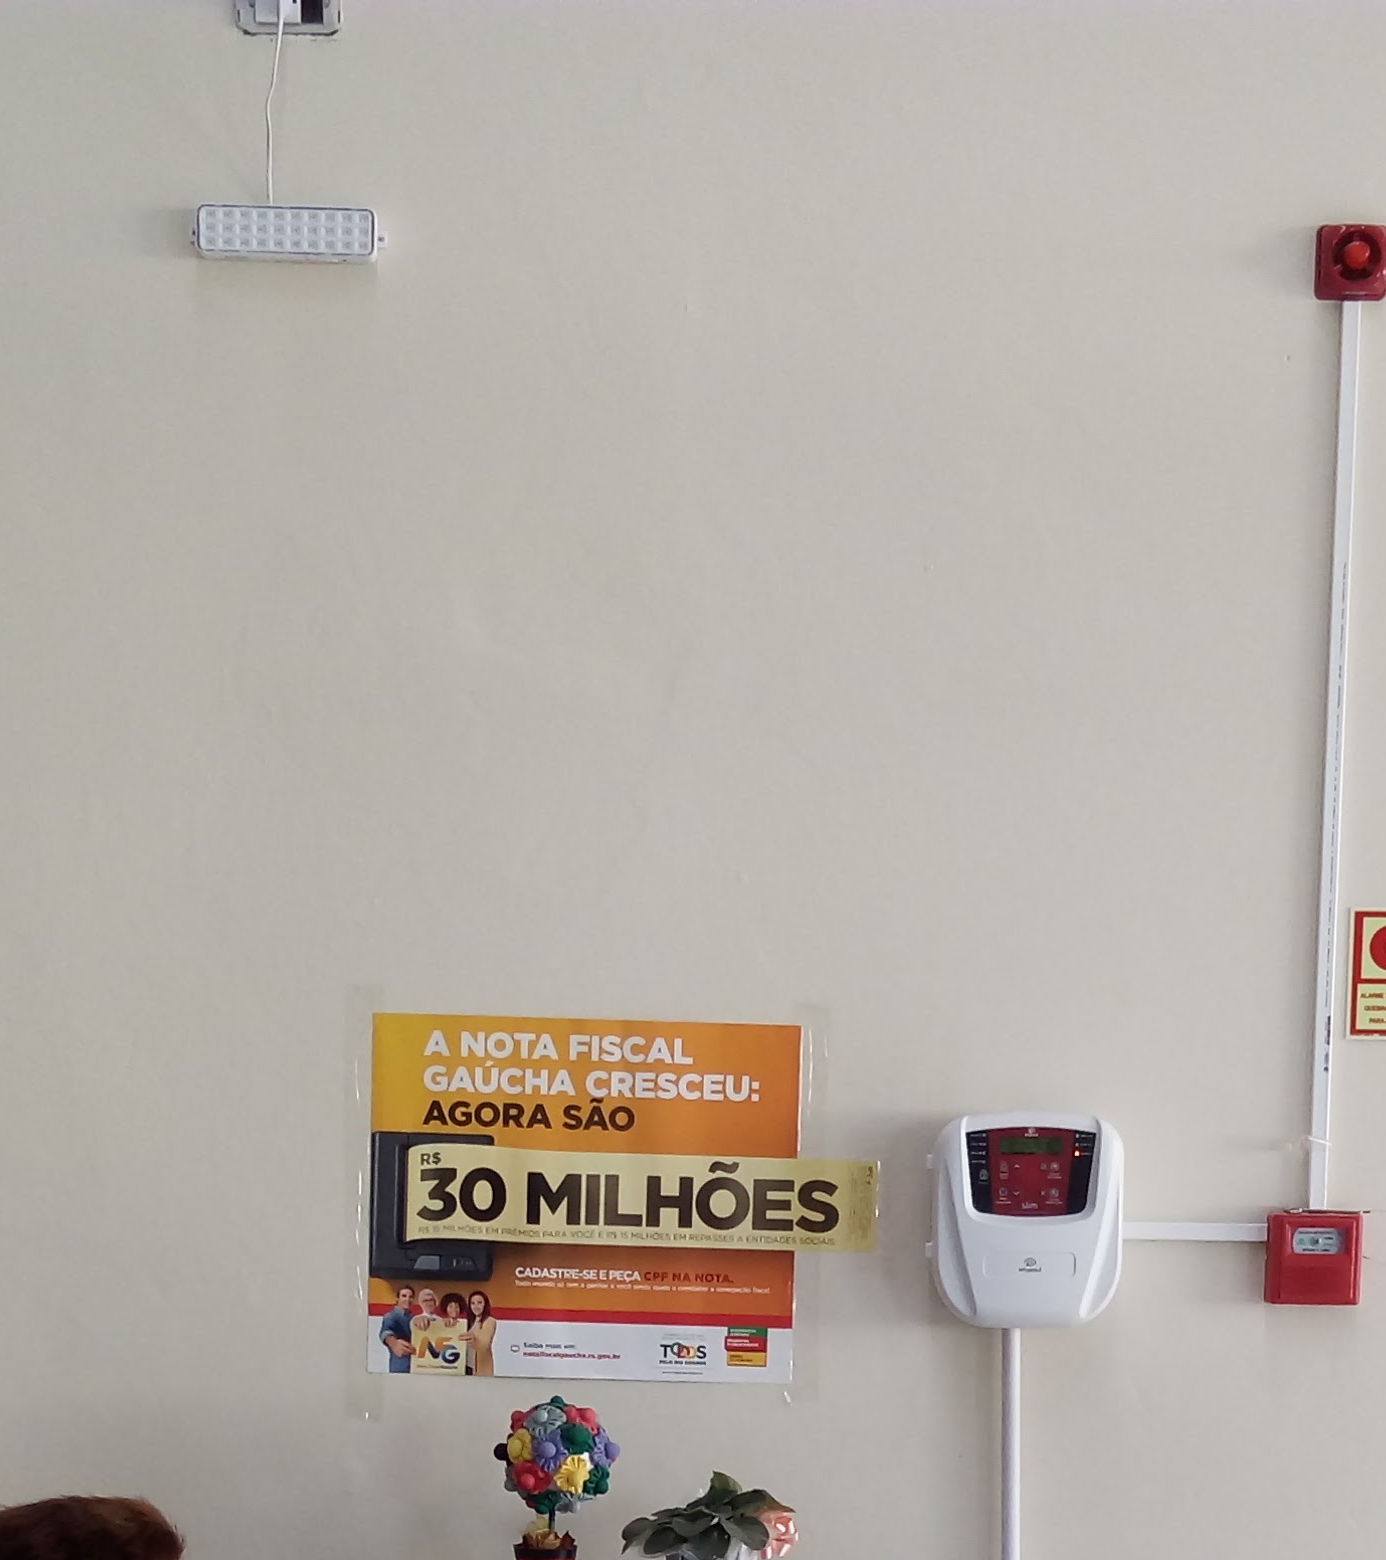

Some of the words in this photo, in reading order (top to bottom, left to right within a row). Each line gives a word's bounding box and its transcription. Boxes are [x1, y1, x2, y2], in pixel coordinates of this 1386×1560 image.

[424, 1030, 451, 1056] A
[461, 1031, 558, 1060] NOTA
[569, 1034, 694, 1064] FISCAL
[423, 1060, 576, 1096] GAÚCHA
[585, 1070, 760, 1102] CRESCEU:
[422, 1100, 552, 1129] AGORA
[562, 1097, 636, 1132] SÃO
[420, 1152, 442, 1166] R$
[416, 1167, 507, 1222] 30
[526, 1161, 840, 1234] MILHÕES
[515, 1266, 598, 1280] CADASTRE-SE
[599, 1269, 607, 1280] E
[609, 1270, 641, 1282] PEÇA
[644, 1271, 669, 1281] CPF
[672, 1272, 691, 1282] NA
[695, 1273, 734, 1283] NOTA.
